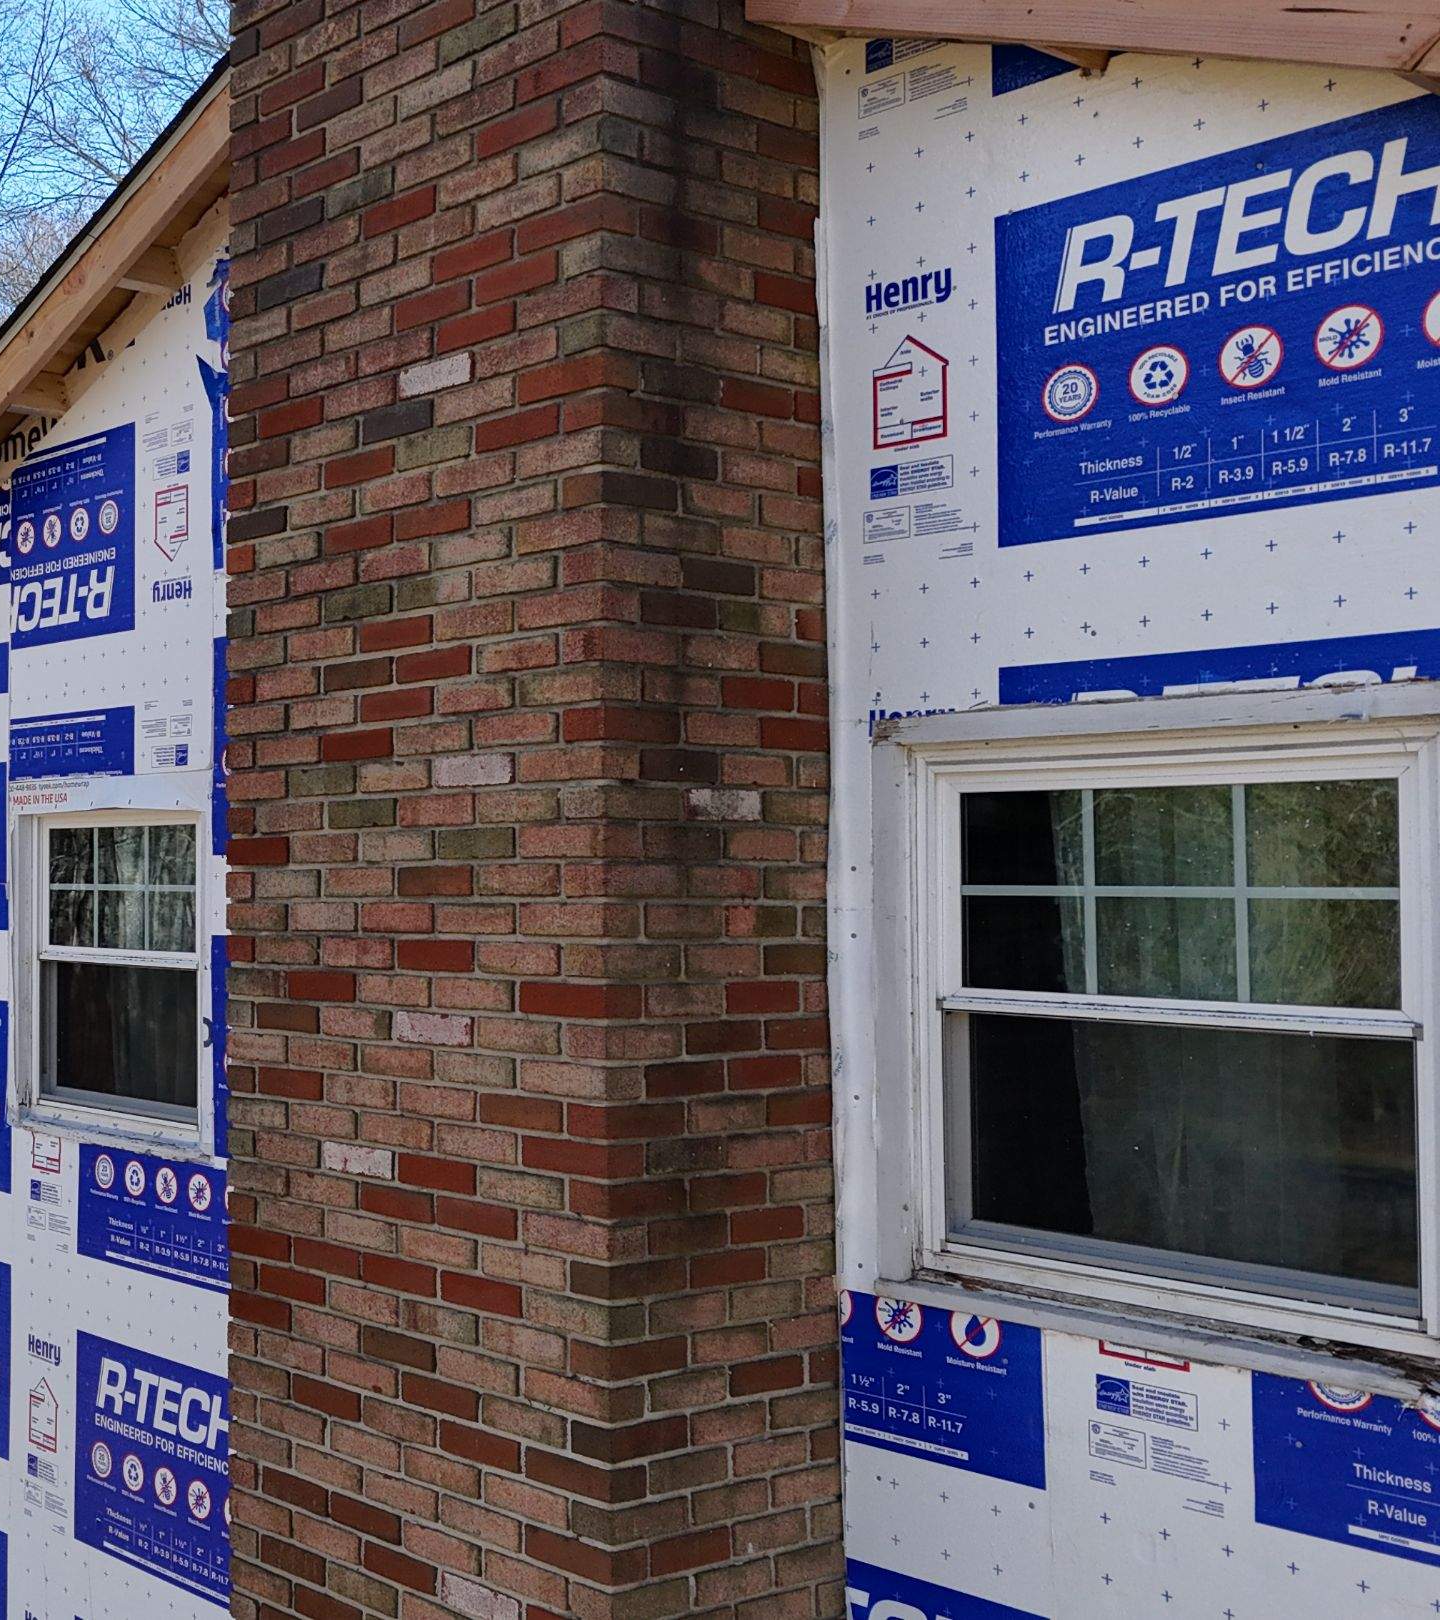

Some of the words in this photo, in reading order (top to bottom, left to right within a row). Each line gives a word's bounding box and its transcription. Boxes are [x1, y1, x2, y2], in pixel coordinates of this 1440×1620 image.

[1052, 137, 1440, 315] R-TECH
[865, 267, 952, 314] Henry
[1044, 290, 1211, 346] ENGINEERED
[1220, 275, 1276, 308] FOR
[1319, 334, 1338, 343] MOLD
[1062, 381, 1078, 395] 20
[1318, 376, 1340, 387] Mold
[1341, 368, 1382, 384] Resistant
[1059, 393, 1082, 404] YEARS
[1220, 393, 1247, 406] Insect
[1248, 385, 1285, 402] Resistant
[1128, 412, 1149, 423] 100%
[1150, 404, 1191, 419] Recyclable
[1034, 425, 1078, 440] Performance
[1080, 419, 1112, 432] Warranty
[1079, 455, 1143, 476] Thickness
[1090, 486, 1139, 504] R-Value
[1171, 475, 1194, 491] R-2
[1219, 466, 1254, 484] R-3.9
[1272, 458, 1309, 476] R-5.9
[1329, 448, 1367, 467] R-7.8
[1383, 437, 1432, 459] R-11.7
[43, 557, 61, 575] FOR
[62, 547, 116, 569] ENGINEERED
[152, 580, 193, 602] Henry
[13, 795, 32, 805] MADE
[32, 795, 40, 805] IN
[41, 794, 53, 804] THE
[54, 793, 68, 803] USA
[108, 1217, 134, 1231] Thickness
[110, 1234, 131, 1247] R-Value
[139, 1242, 150, 1252] R-2
[193, 1255, 209, 1267] R-7.8
[28, 1333, 61, 1366] Henry
[877, 1342, 892, 1351] Mold
[893, 1345, 922, 1358] Resistant
[946, 1356, 976, 1369] Moisture
[976, 1362, 1007, 1375] Resistant
[96, 1357, 229, 1450] R-TECH
[848, 1397, 880, 1414] R-5.9
[888, 1406, 920, 1424] R-7.8
[928, 1415, 963, 1434] R-11.7
[1296, 1407, 1350, 1426] Performance
[1353, 1418, 1392, 1435] Warranty
[94, 1412, 153, 1446] ENGINEERED
[155, 1436, 174, 1453] FOR
[1352, 1462, 1432, 1494] Thickness
[106, 1507, 132, 1525] Thickness
[1367, 1499, 1427, 1527] R-Value
[108, 1525, 129, 1541] R-Value
[138, 1538, 149, 1550] R-2
